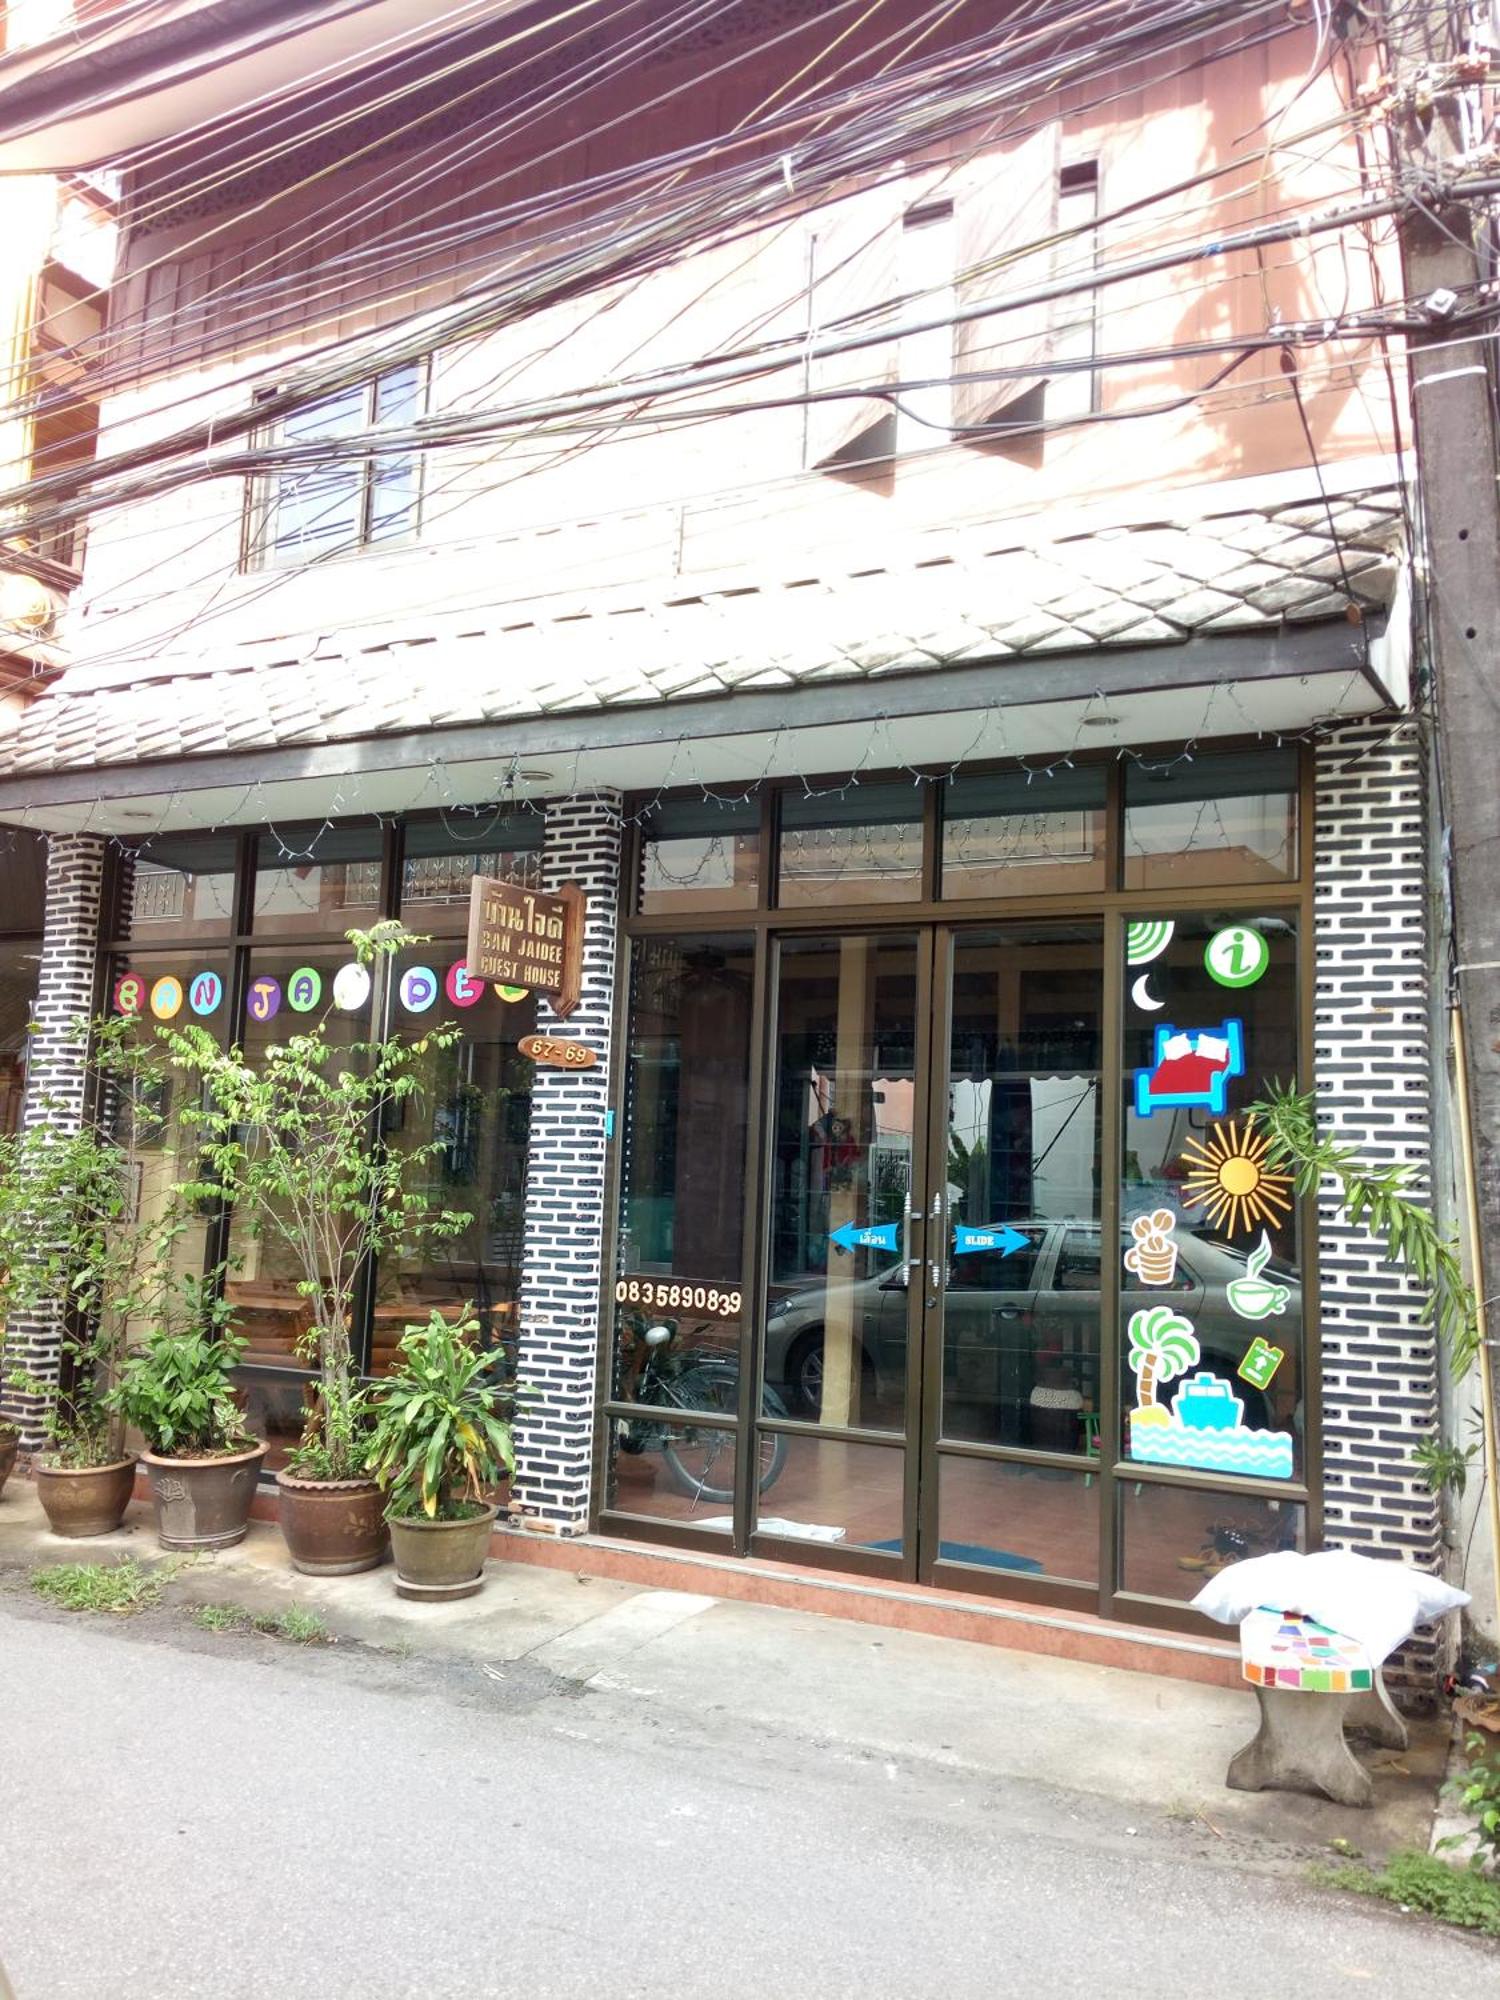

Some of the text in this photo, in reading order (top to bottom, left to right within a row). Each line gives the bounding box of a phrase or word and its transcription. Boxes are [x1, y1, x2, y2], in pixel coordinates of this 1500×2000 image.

[483, 890, 563, 939] บ้านใจดี
[483, 930, 562, 963] BAN JAIDEE
[480, 956, 560, 988] GUEST HOUSE
[118, 966, 522, 1019] BAN JADE
[531, 1039, 587, 1063] 67-69
[964, 1235, 994, 1246] SLIDE
[615, 1281, 742, 1315] 0835890839
